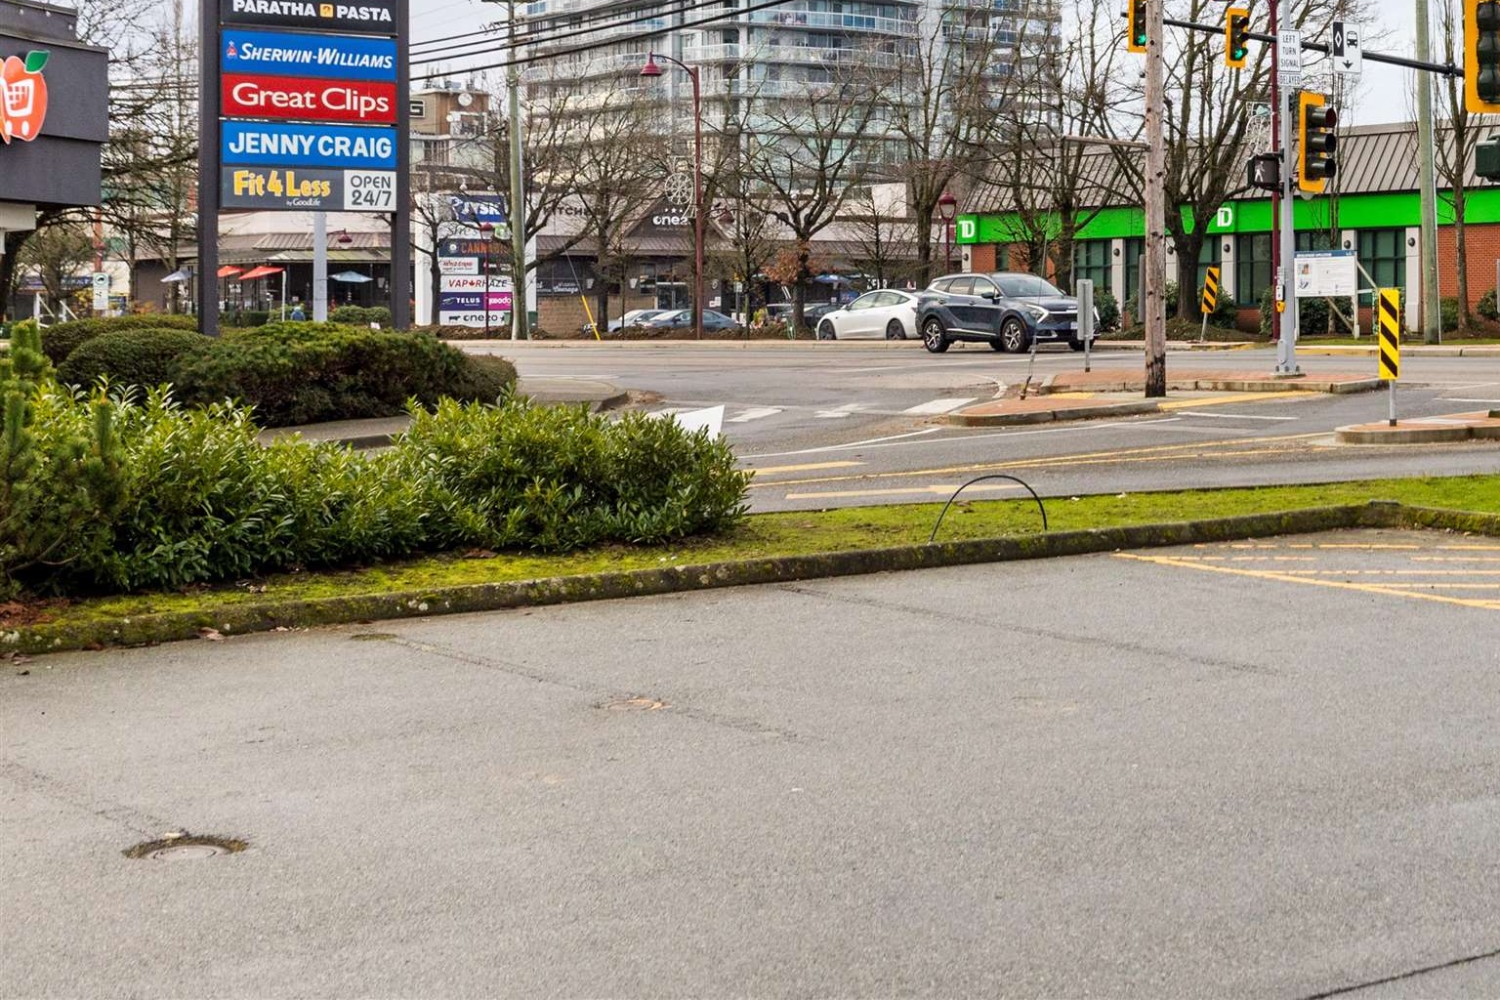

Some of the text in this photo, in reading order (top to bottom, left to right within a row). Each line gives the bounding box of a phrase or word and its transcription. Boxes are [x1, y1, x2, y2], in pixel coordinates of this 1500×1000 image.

[337, 5, 391, 21] PASTA
[1282, 34, 1296, 43] LEFT
[240, 43, 393, 69] SHERWIN-WILLIAMS
[1282, 46, 1297, 55] TURN
[1280, 59, 1299, 68] SIGNAL
[1280, 74, 1300, 85] DELAYED
[232, 82, 316, 109] Great
[321, 88, 389, 118] Clips
[229, 132, 392, 158] JENNY CRAIG
[233, 170, 331, 197] Fit 4 Less
[350, 175, 391, 189] OPEN
[351, 190, 392, 207] 24/7
[1217, 208, 1232, 227] TD
[959, 221, 975, 238] TD
